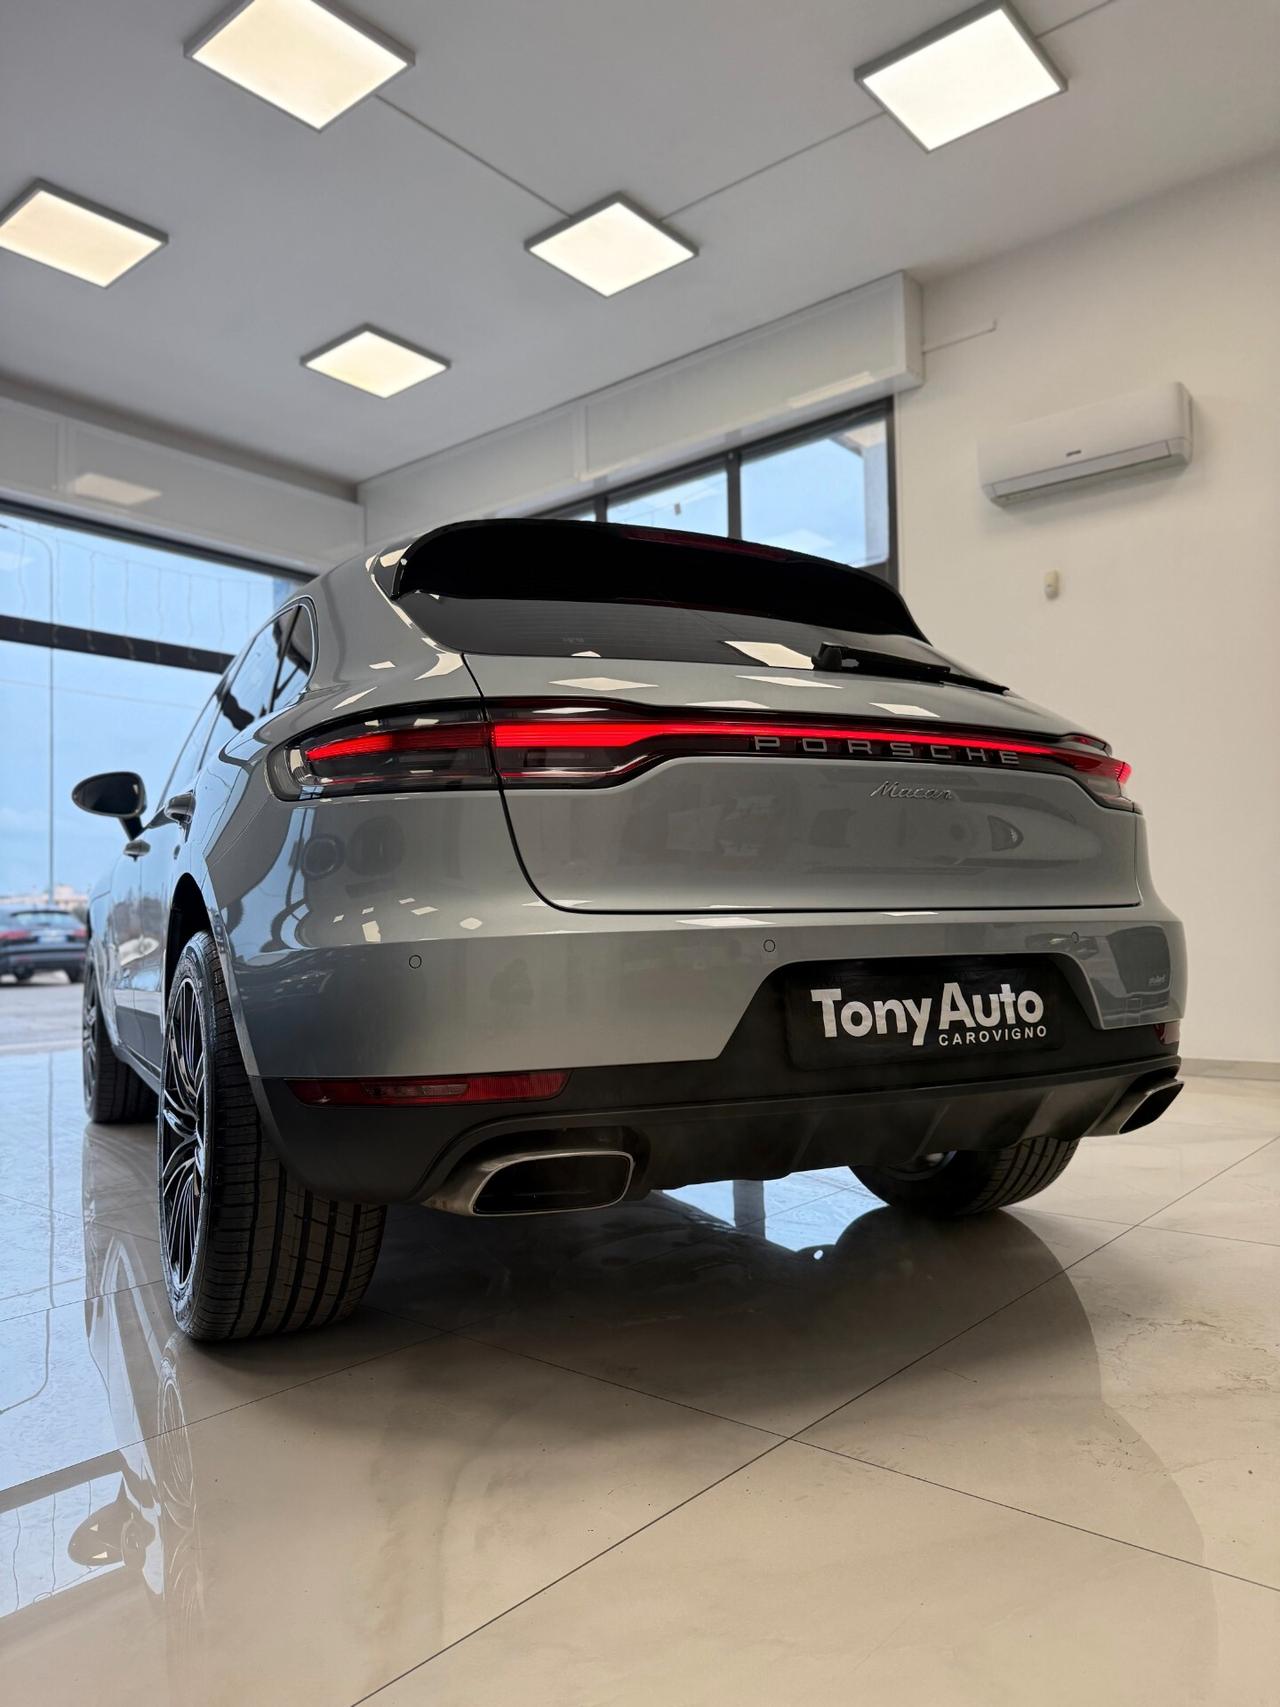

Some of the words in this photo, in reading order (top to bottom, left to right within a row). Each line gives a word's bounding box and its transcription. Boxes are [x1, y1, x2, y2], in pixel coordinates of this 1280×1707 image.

[754, 736, 1019, 764] PORSCHE
[870, 781, 952, 800] Macan
[938, 1025, 1047, 1046] CAROVIGNO
